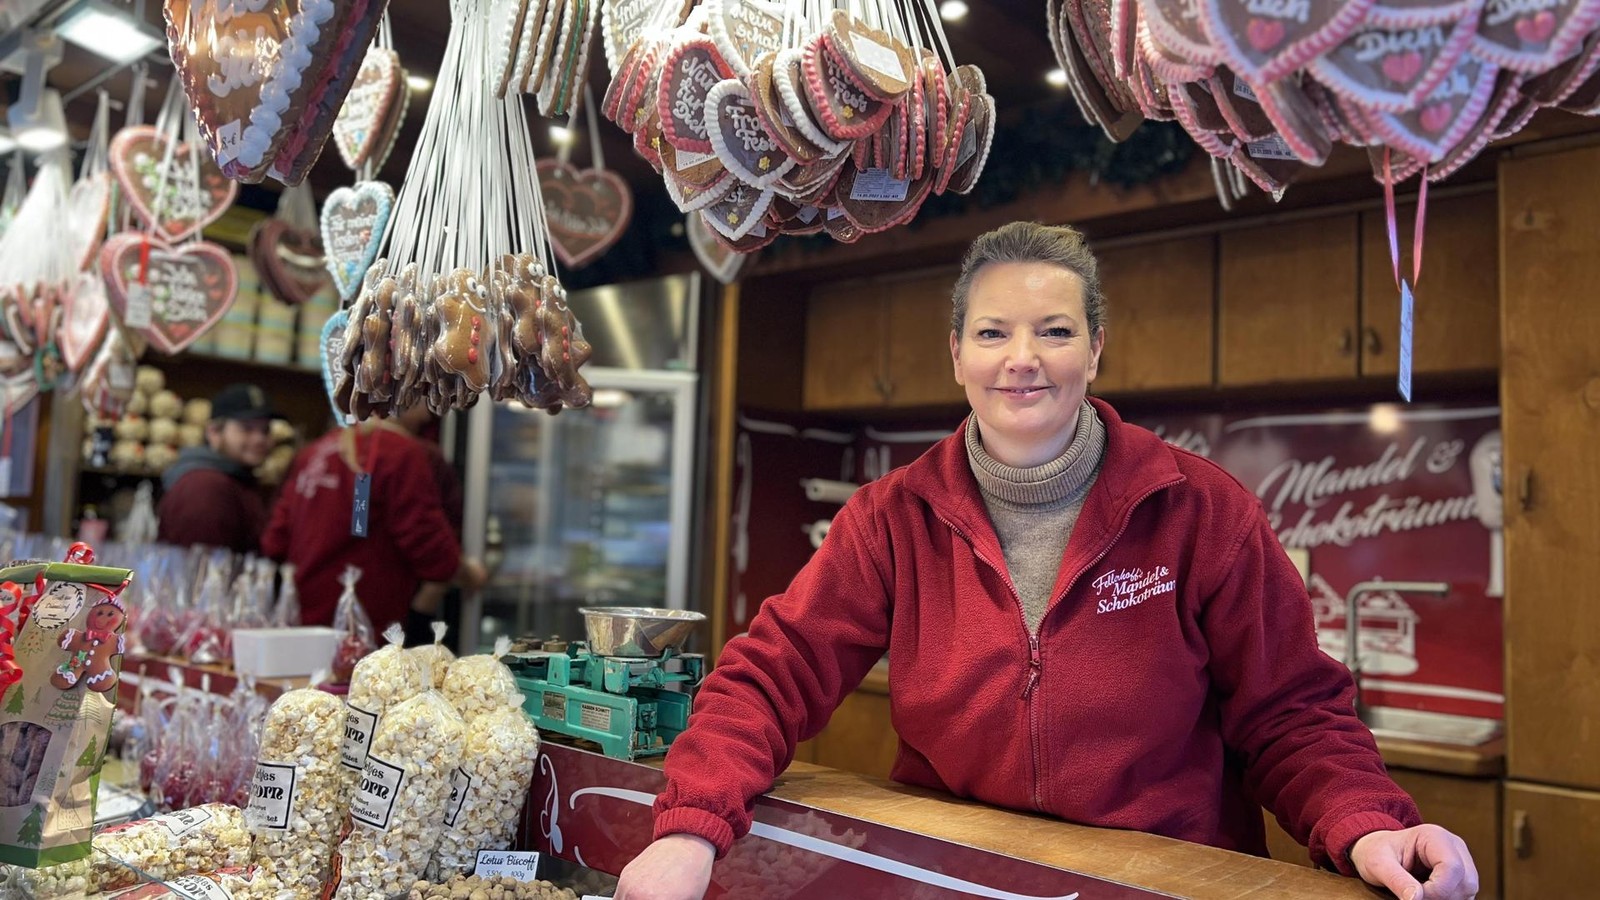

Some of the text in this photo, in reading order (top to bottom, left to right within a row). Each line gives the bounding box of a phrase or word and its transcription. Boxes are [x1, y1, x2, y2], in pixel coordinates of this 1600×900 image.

[1355, 25, 1445, 62] Dich
[682, 57, 715, 91] Nur
[829, 77, 868, 112] Fest
[672, 101, 708, 139] Dich
[736, 128, 777, 151] Fest
[1257, 437, 1427, 511] Mandel
[1426, 439, 1465, 474] &
[1267, 493, 1480, 548] chokoträum
[1112, 565, 1160, 597] Mandel
[480, 854, 537, 871] Lotus Biscoff
